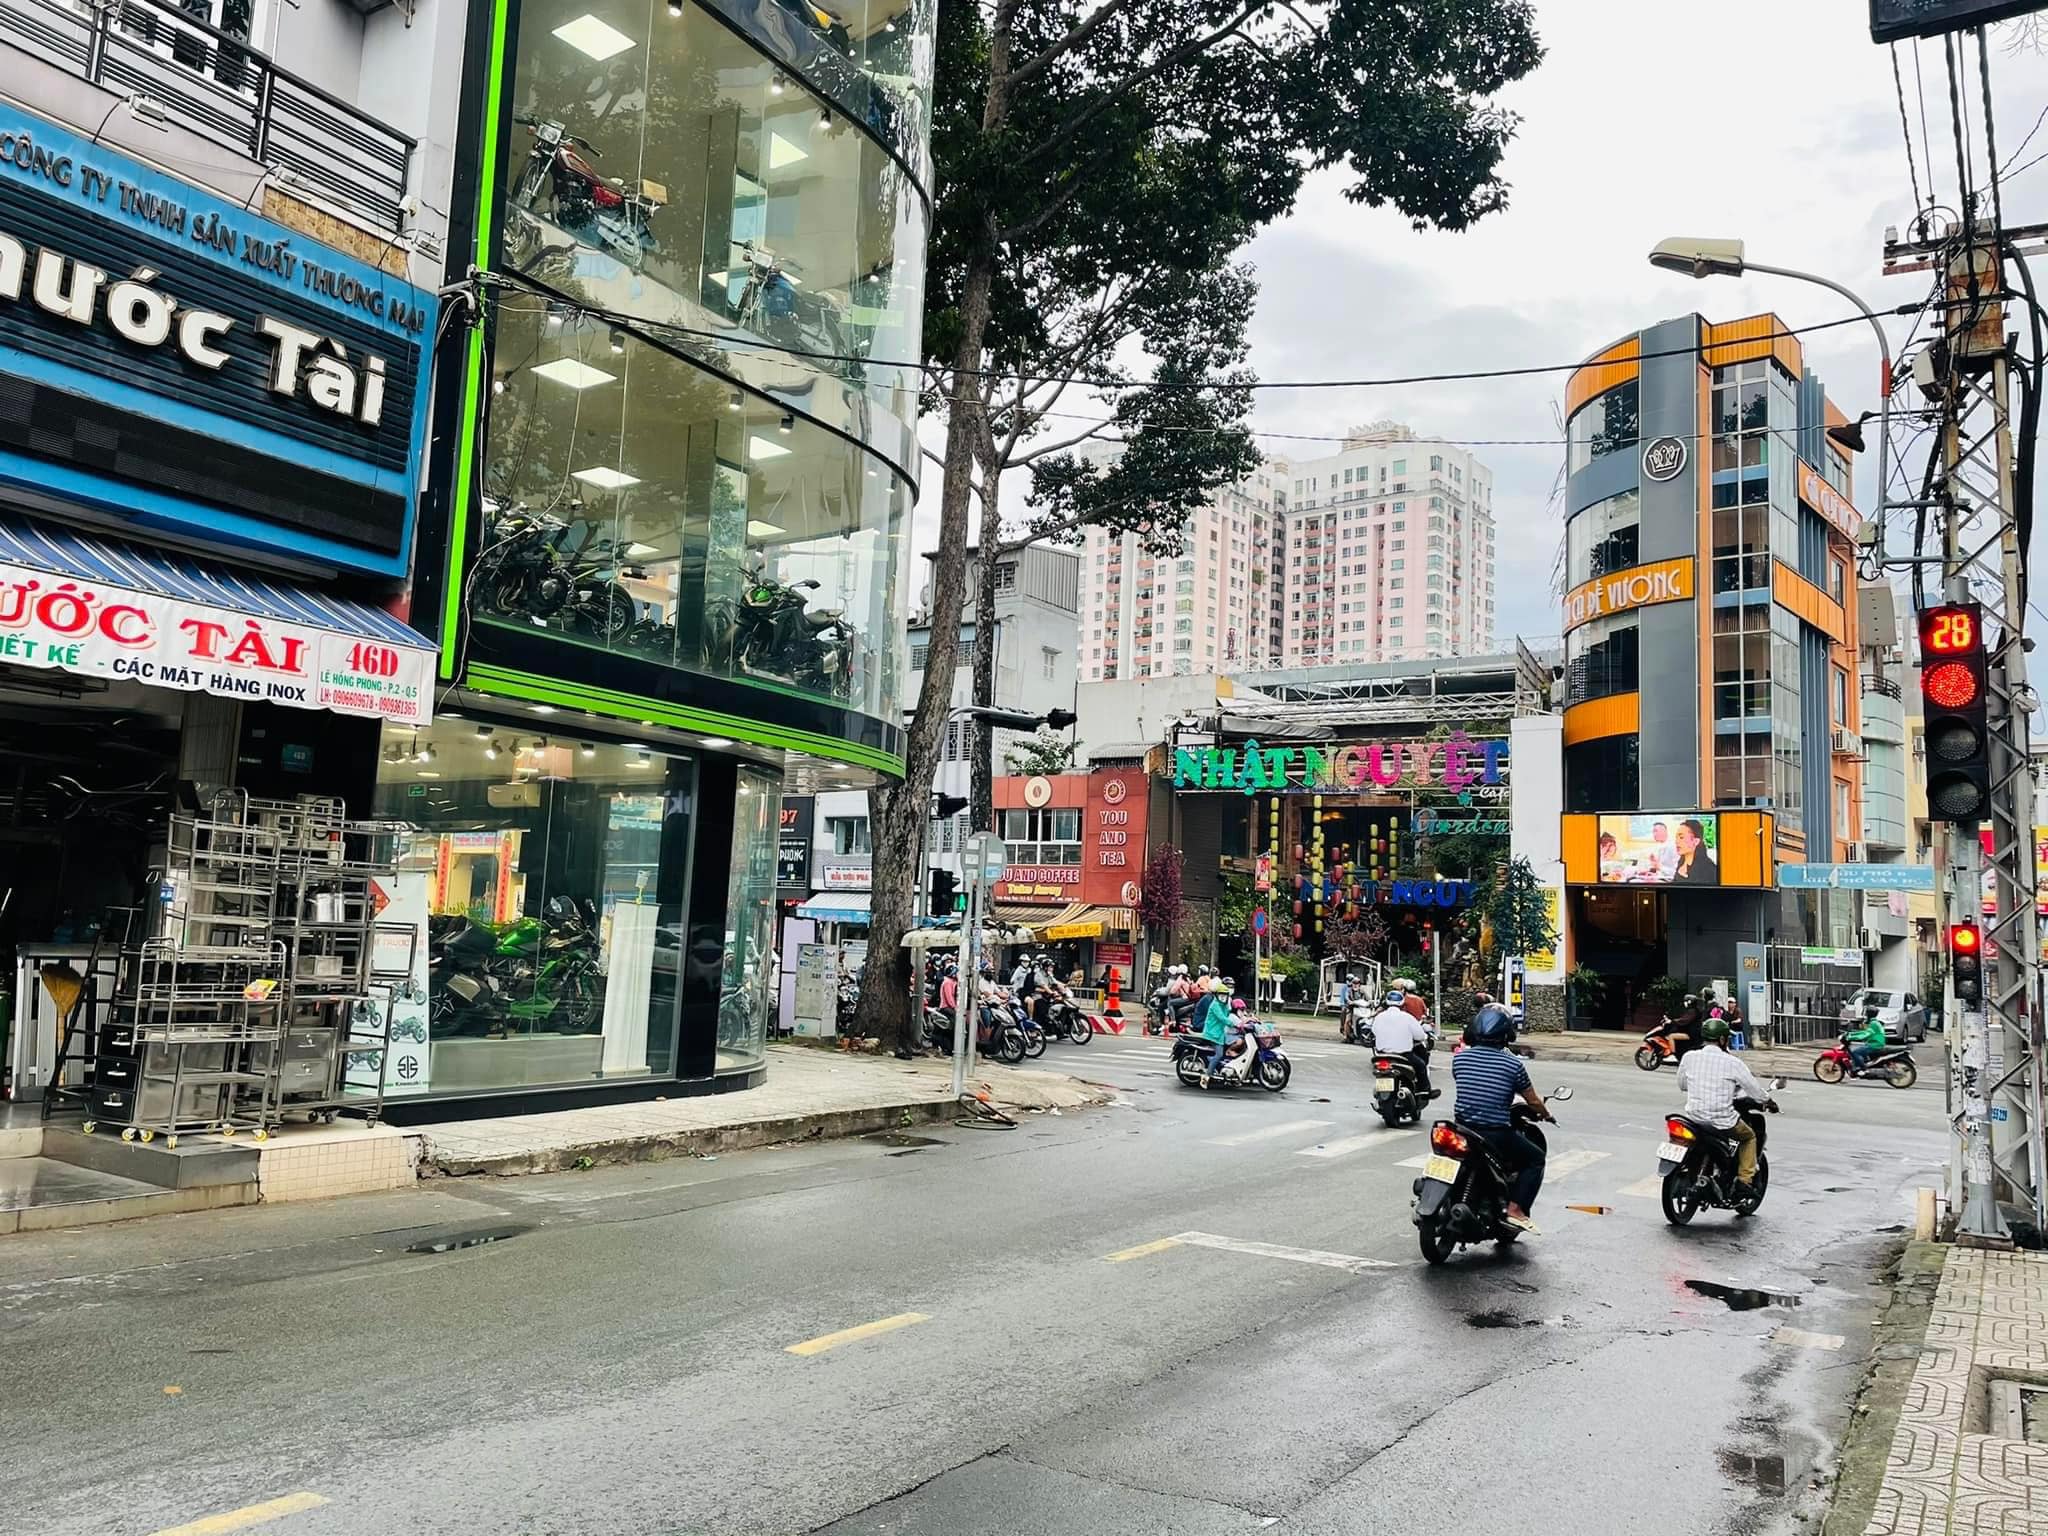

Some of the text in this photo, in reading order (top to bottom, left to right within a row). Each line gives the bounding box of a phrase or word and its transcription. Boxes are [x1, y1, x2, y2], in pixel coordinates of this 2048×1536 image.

[0, 134, 425, 336] CÔNG TY TNHH SẢN XUẤT THƯƠNG MẠI
[254, 312, 388, 427] Tài
[180, 619, 309, 677] TÀI
[1932, 613, 1972, 649] 28
[48, 643, 85, 665] KẾ
[113, 656, 154, 678] CÁC
[160, 666, 203, 688] MẶT
[210, 673, 260, 694] HÀNG
[266, 683, 306, 701] INOX
[345, 642, 398, 677] 46D
[356, 677, 382, 691] PHONG
[1173, 739, 1295, 796] NHẬT
[1303, 730, 1511, 793] NGUYỆT
[1100, 811, 1128, 825] YOU
[1099, 832, 1127, 845] AND
[1014, 868, 1037, 882] AND
[1038, 868, 1080, 883] COFFEE
[1099, 852, 1126, 865] TEA
[1743, 957, 1760, 969] 907
